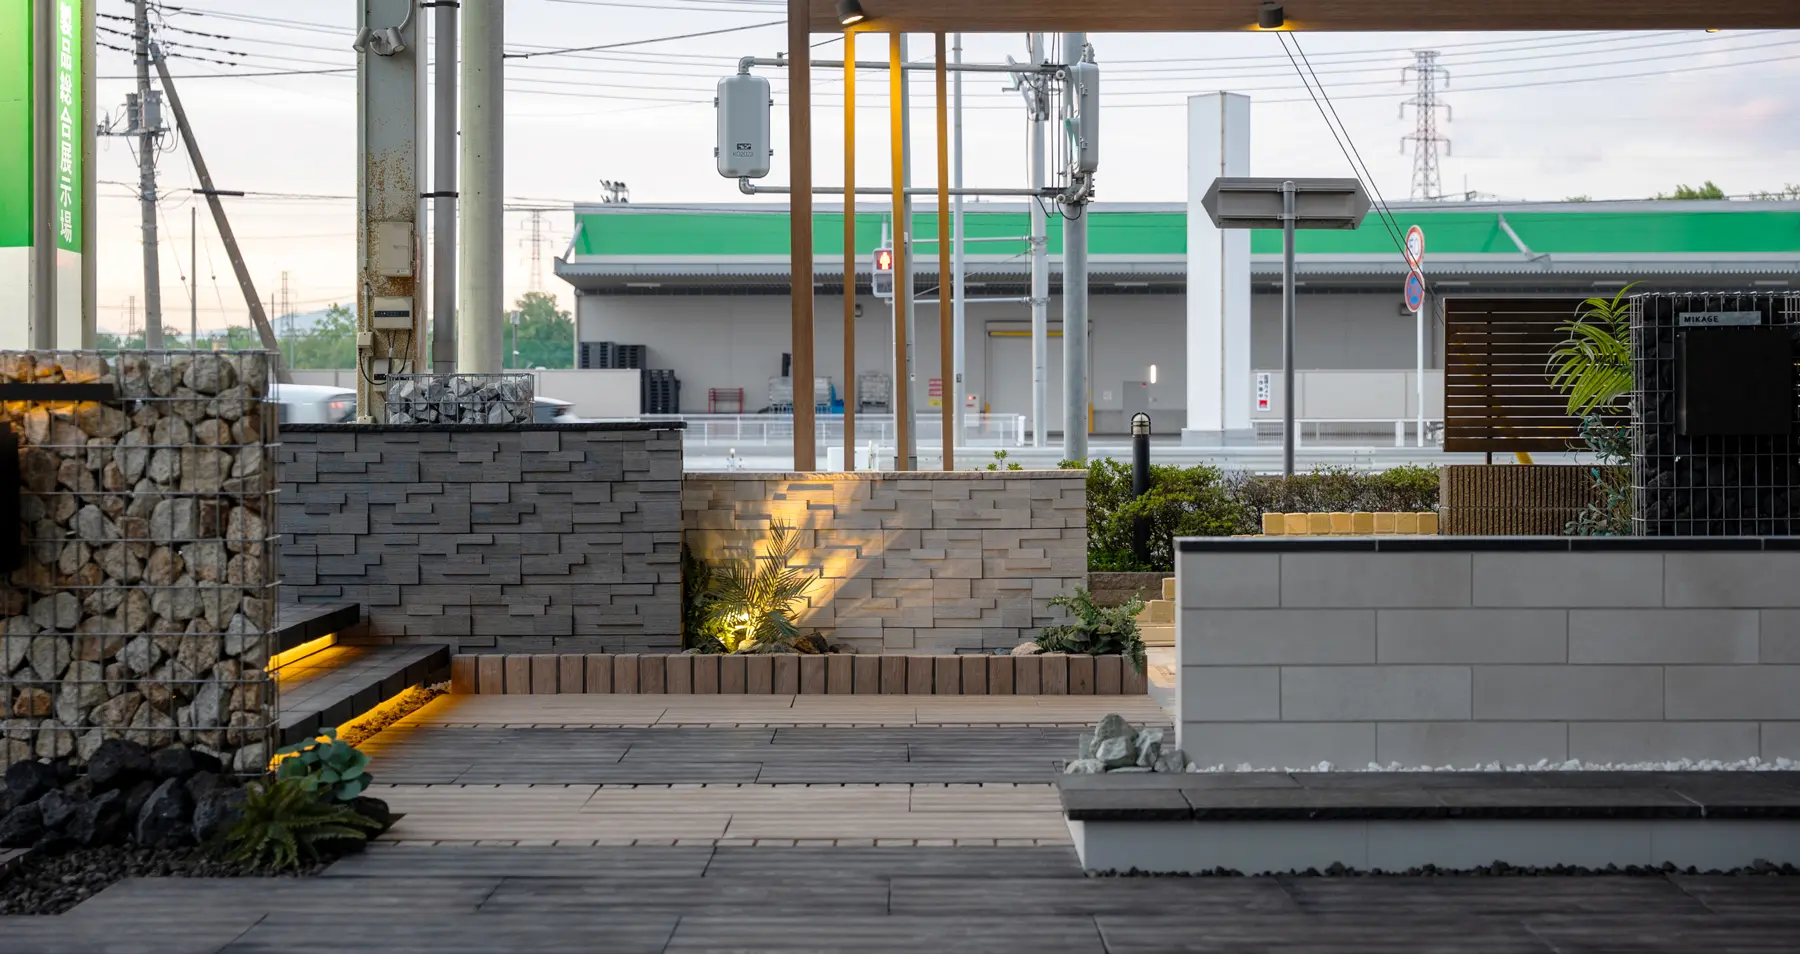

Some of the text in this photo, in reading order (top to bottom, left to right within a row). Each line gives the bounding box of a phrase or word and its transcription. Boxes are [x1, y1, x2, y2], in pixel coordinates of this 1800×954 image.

[59, 2, 73, 244] 製品総合展示場
[1683, 315, 1719, 323] MIKAGE
